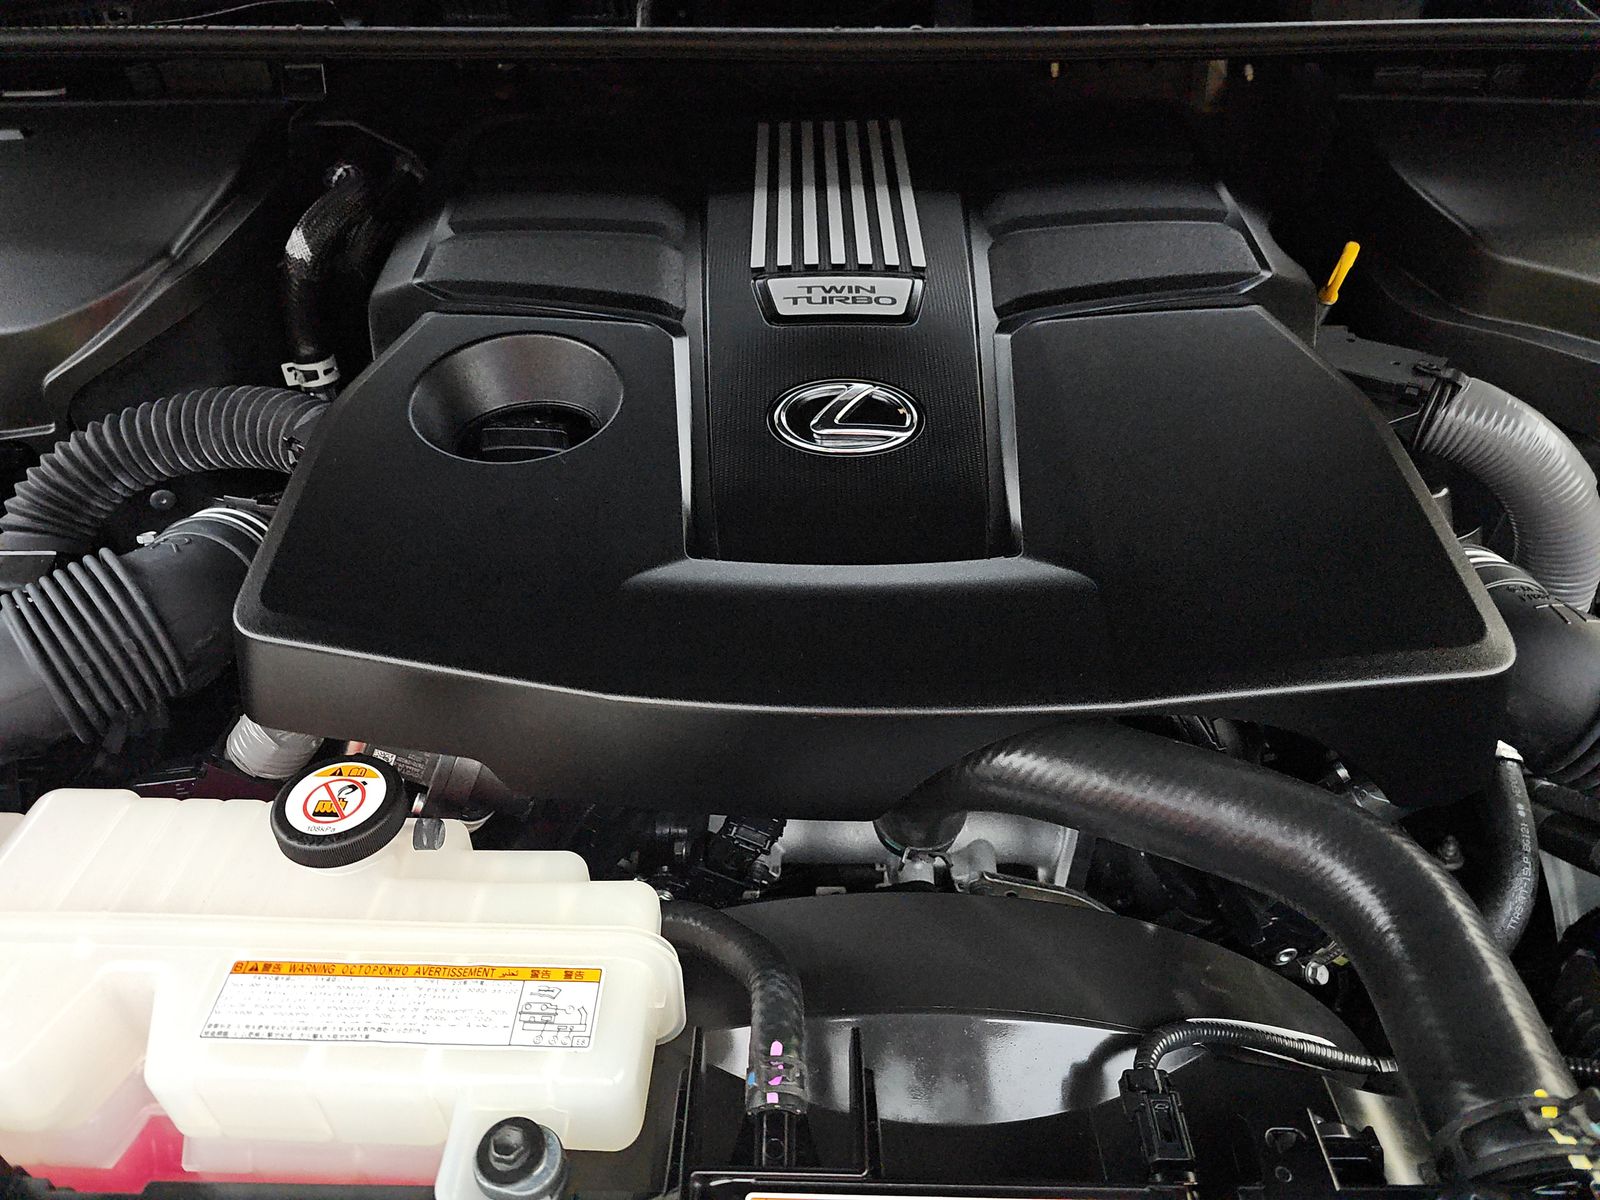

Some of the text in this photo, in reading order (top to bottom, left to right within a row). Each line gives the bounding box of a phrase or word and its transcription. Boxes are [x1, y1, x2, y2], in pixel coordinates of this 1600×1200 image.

[797, 285, 876, 294] TWIN
[783, 295, 898, 306] TURBO
[288, 964, 336, 975] WARNING
[414, 966, 497, 978] AVERTISSEMENT
